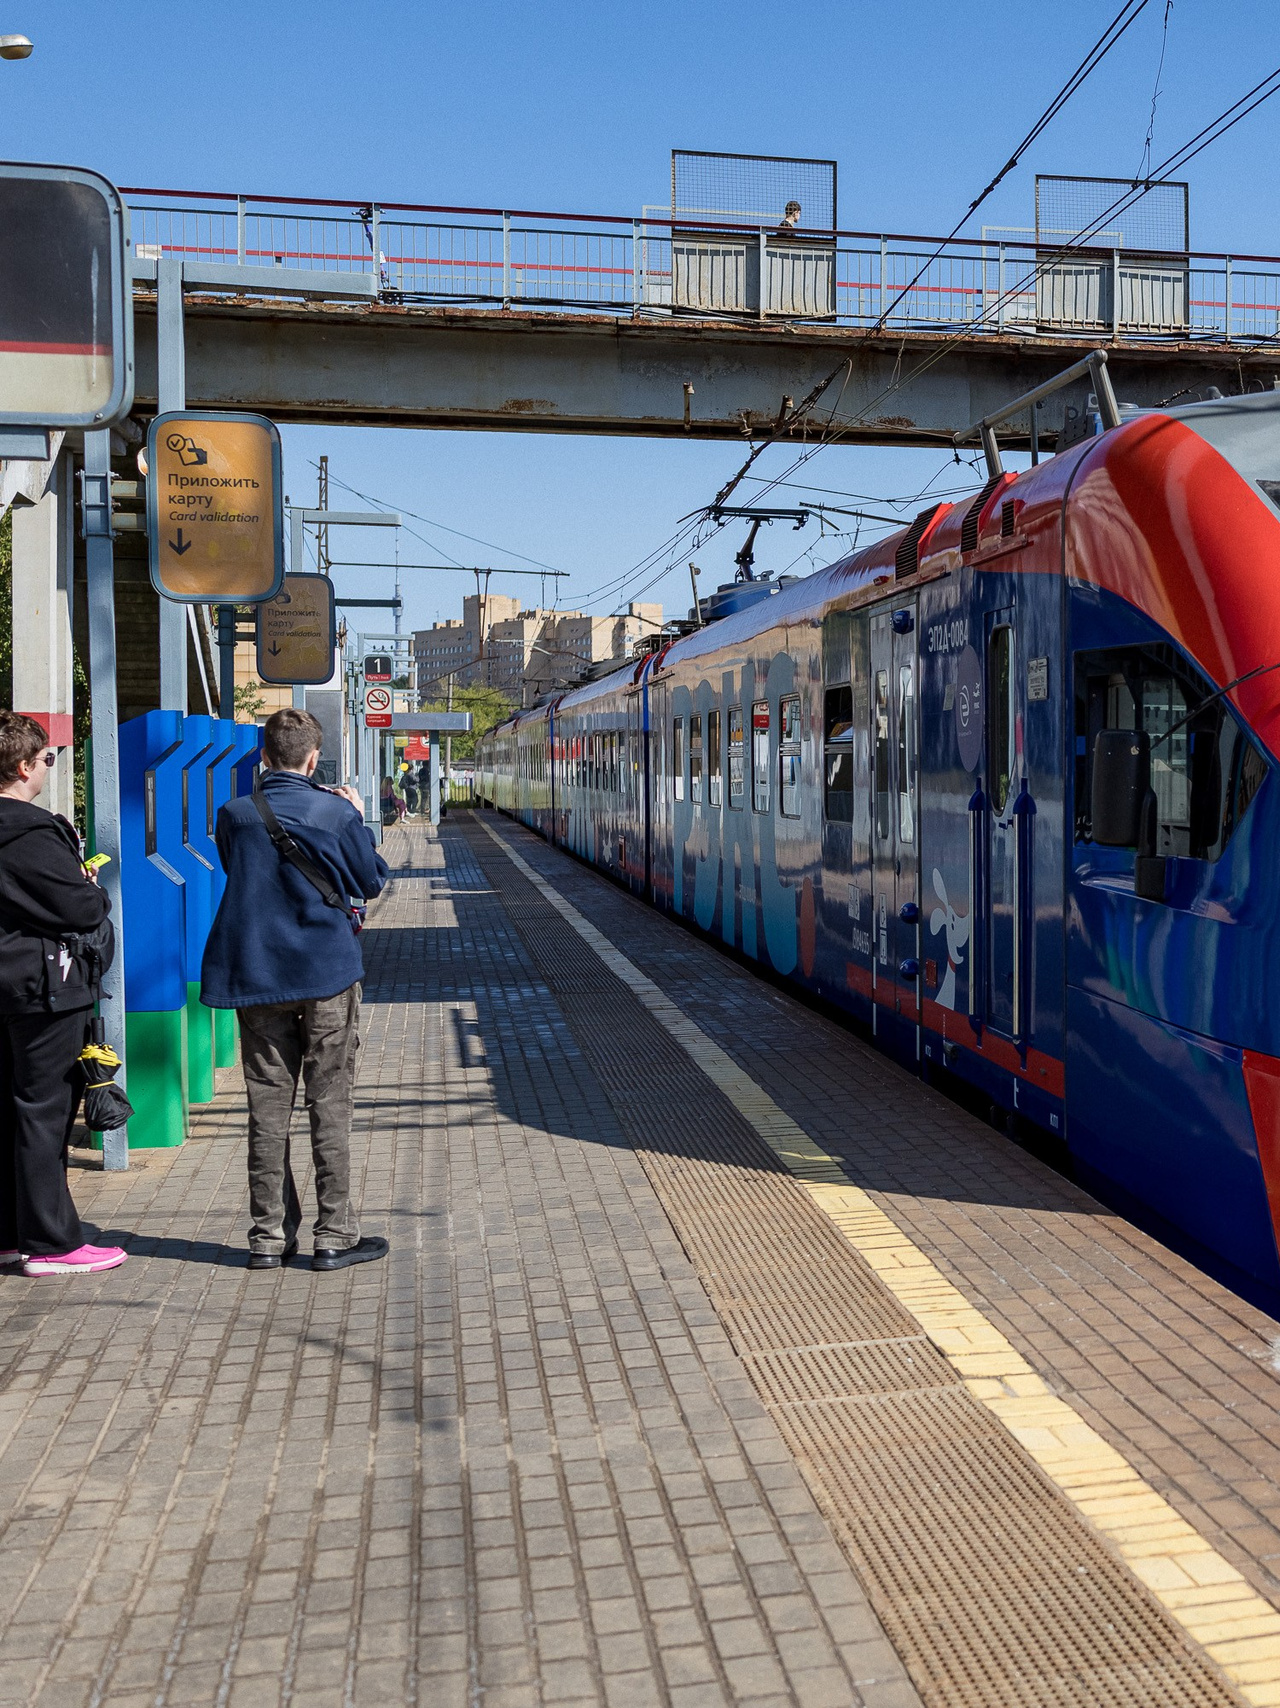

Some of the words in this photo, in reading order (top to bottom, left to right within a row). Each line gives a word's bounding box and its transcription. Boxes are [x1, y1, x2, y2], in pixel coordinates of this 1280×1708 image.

[168, 473, 260, 489] Приложить
[168, 494, 213, 508] карту
[169, 511, 197, 521] Card
[200, 511, 260, 523] validation
[267, 608, 321, 617] Приложить
[928, 619, 969, 653] ЭП2Д-0084
[373, 658, 381, 673] 1
